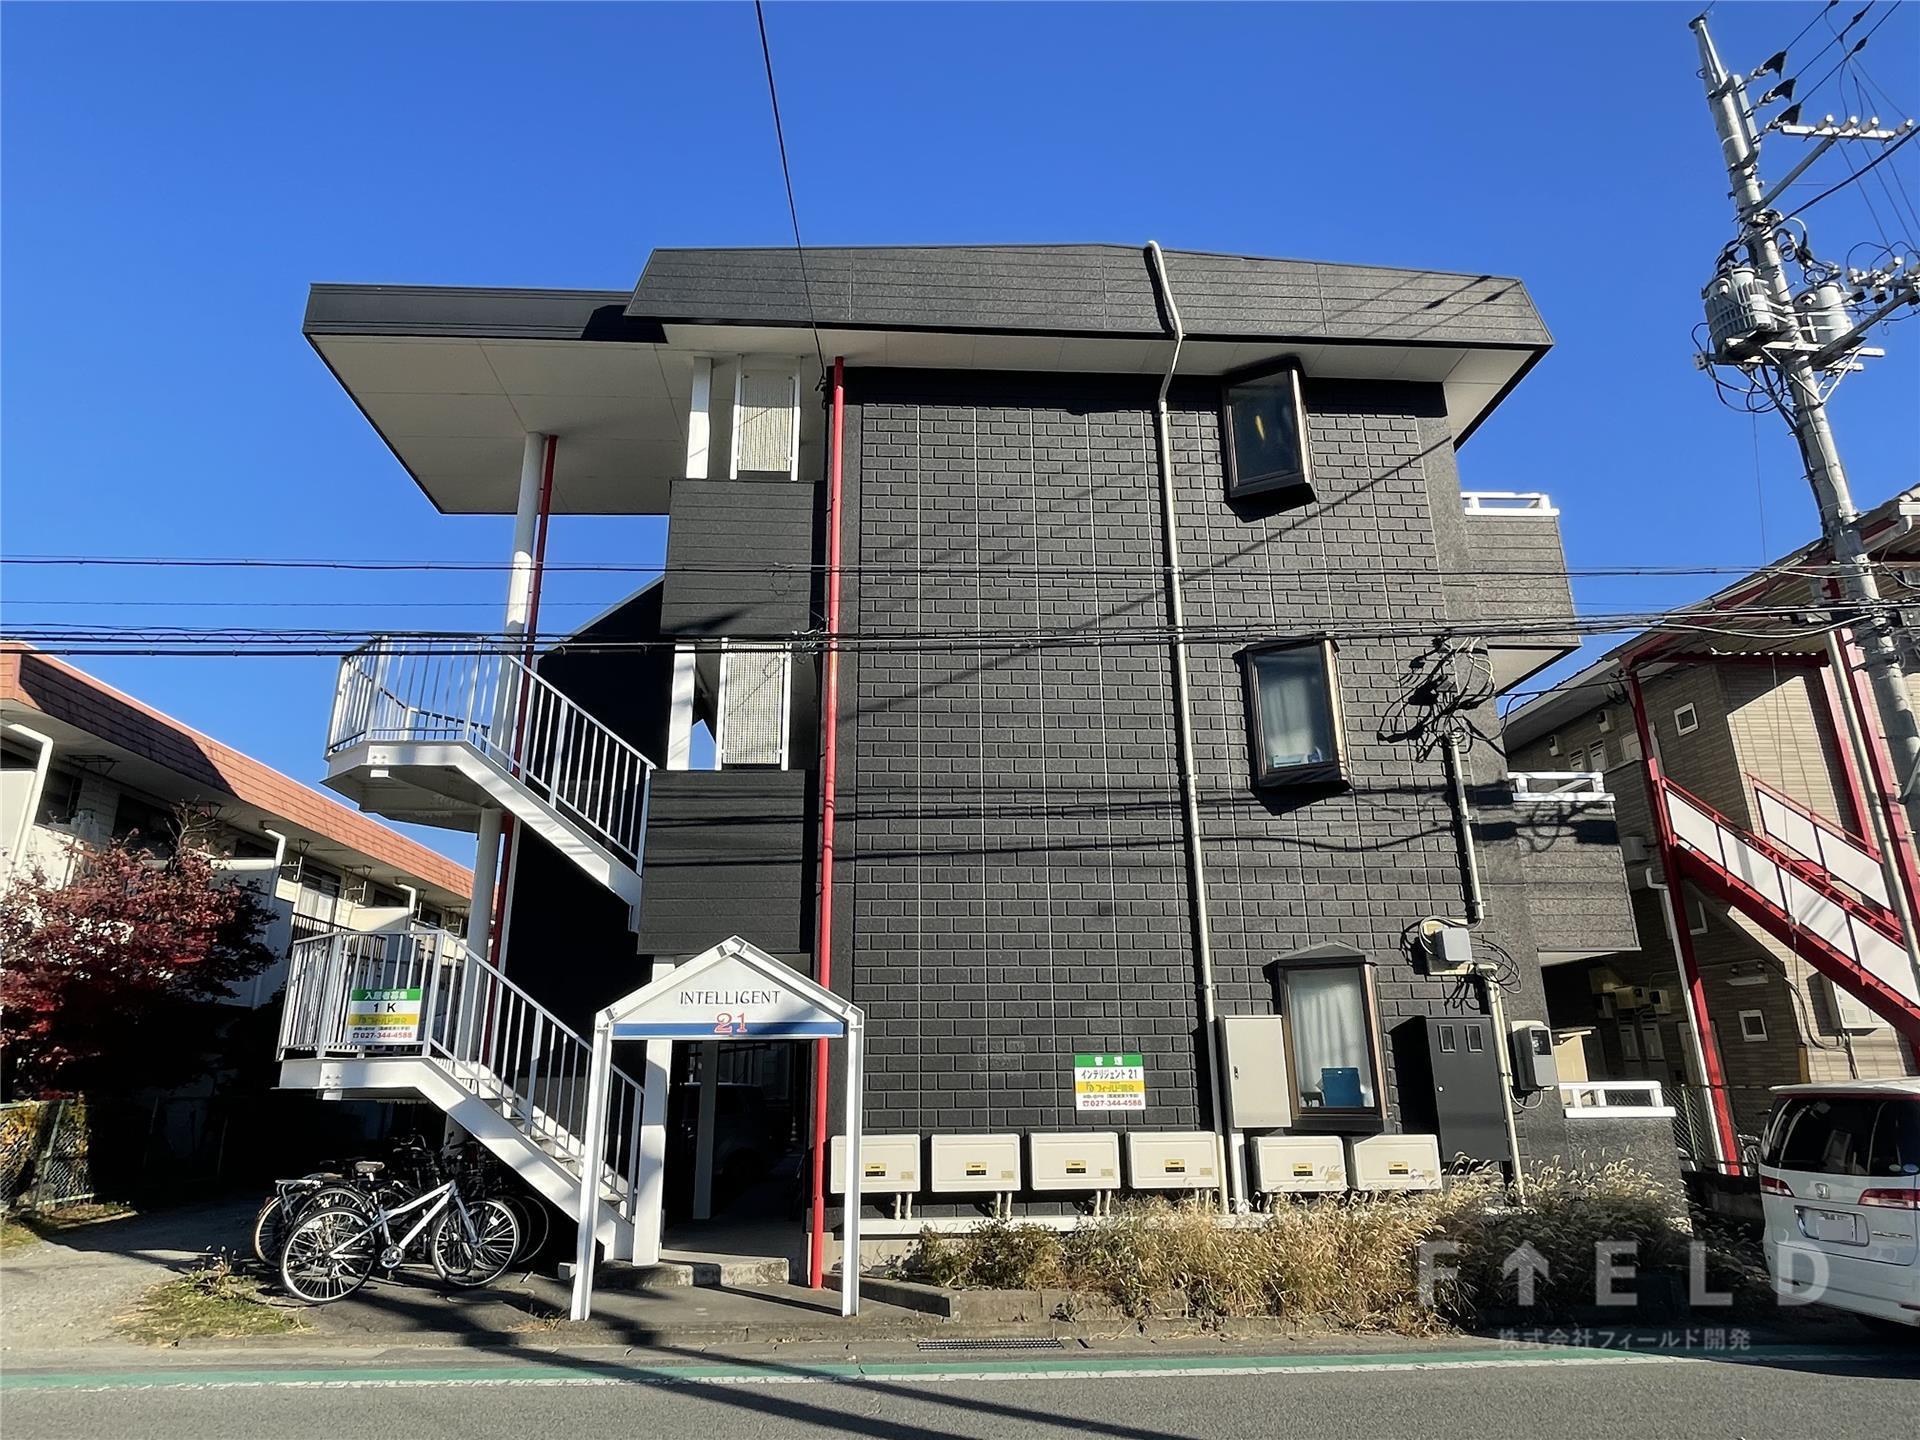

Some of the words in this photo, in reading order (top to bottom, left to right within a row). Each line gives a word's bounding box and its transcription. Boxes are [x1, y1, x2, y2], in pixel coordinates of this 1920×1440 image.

[680, 990, 780, 1005] INTELLIGENT
[714, 1012, 748, 1034] 21
[1081, 1069, 1126, 1080] インテリジェント
